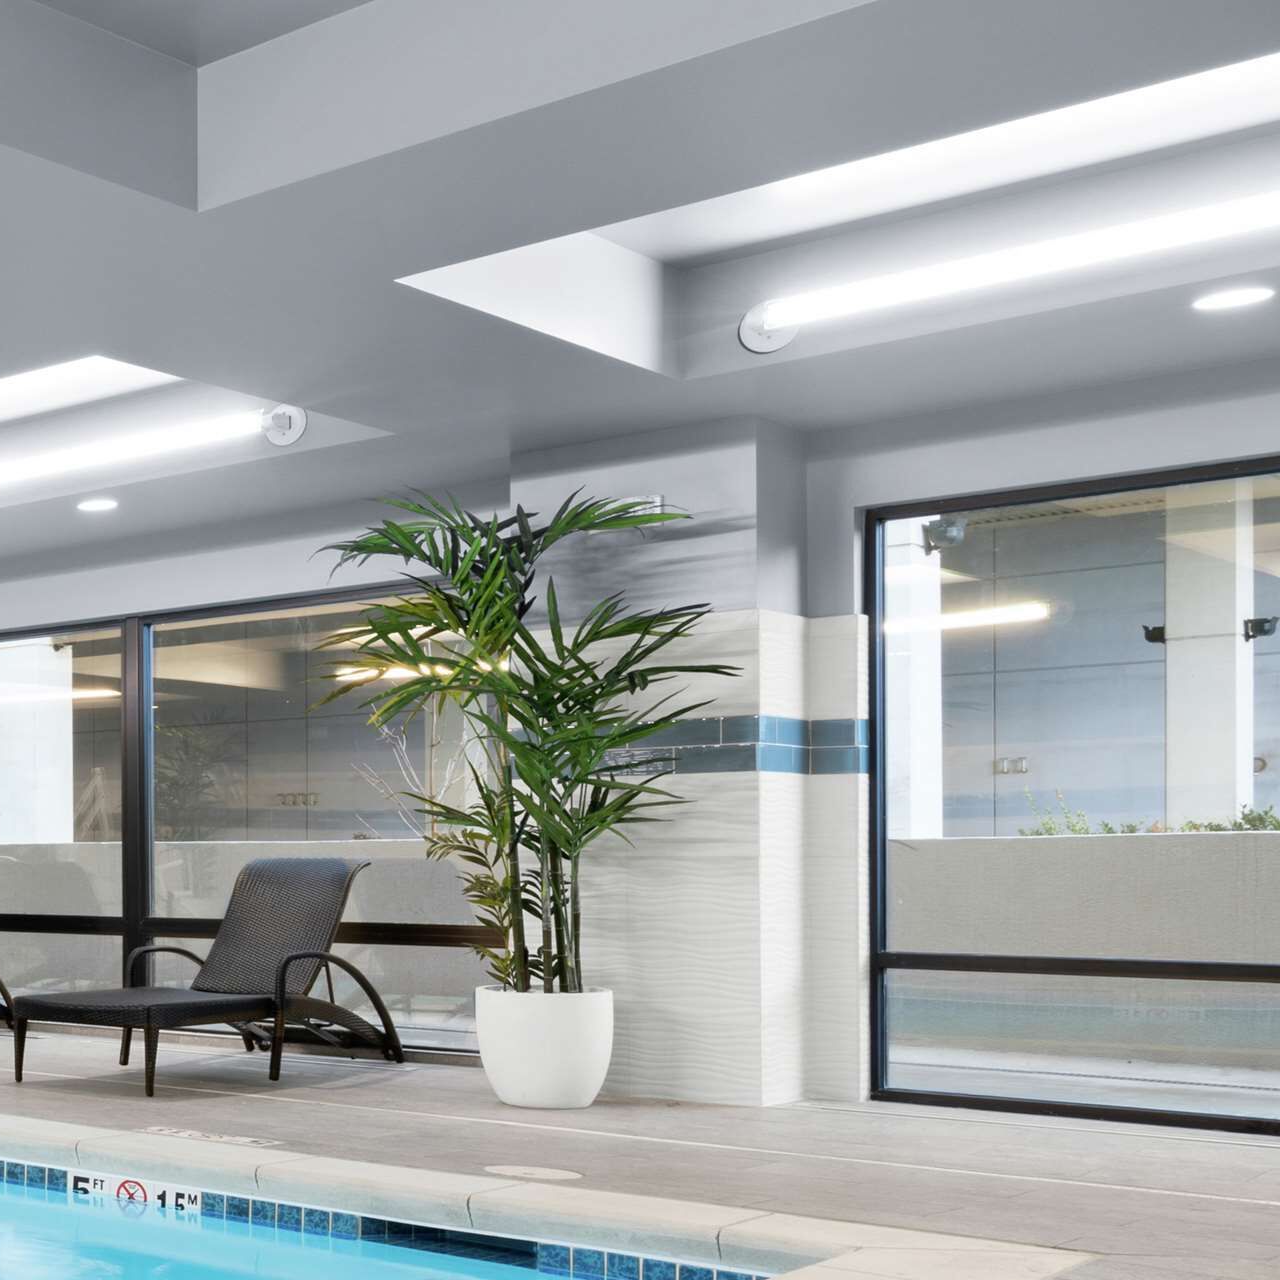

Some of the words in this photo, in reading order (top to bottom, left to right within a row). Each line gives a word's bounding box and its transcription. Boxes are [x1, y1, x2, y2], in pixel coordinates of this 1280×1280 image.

[72, 1175, 90, 1195] 5
[93, 1178, 104, 1190] FT
[187, 1194, 198, 1206] M
